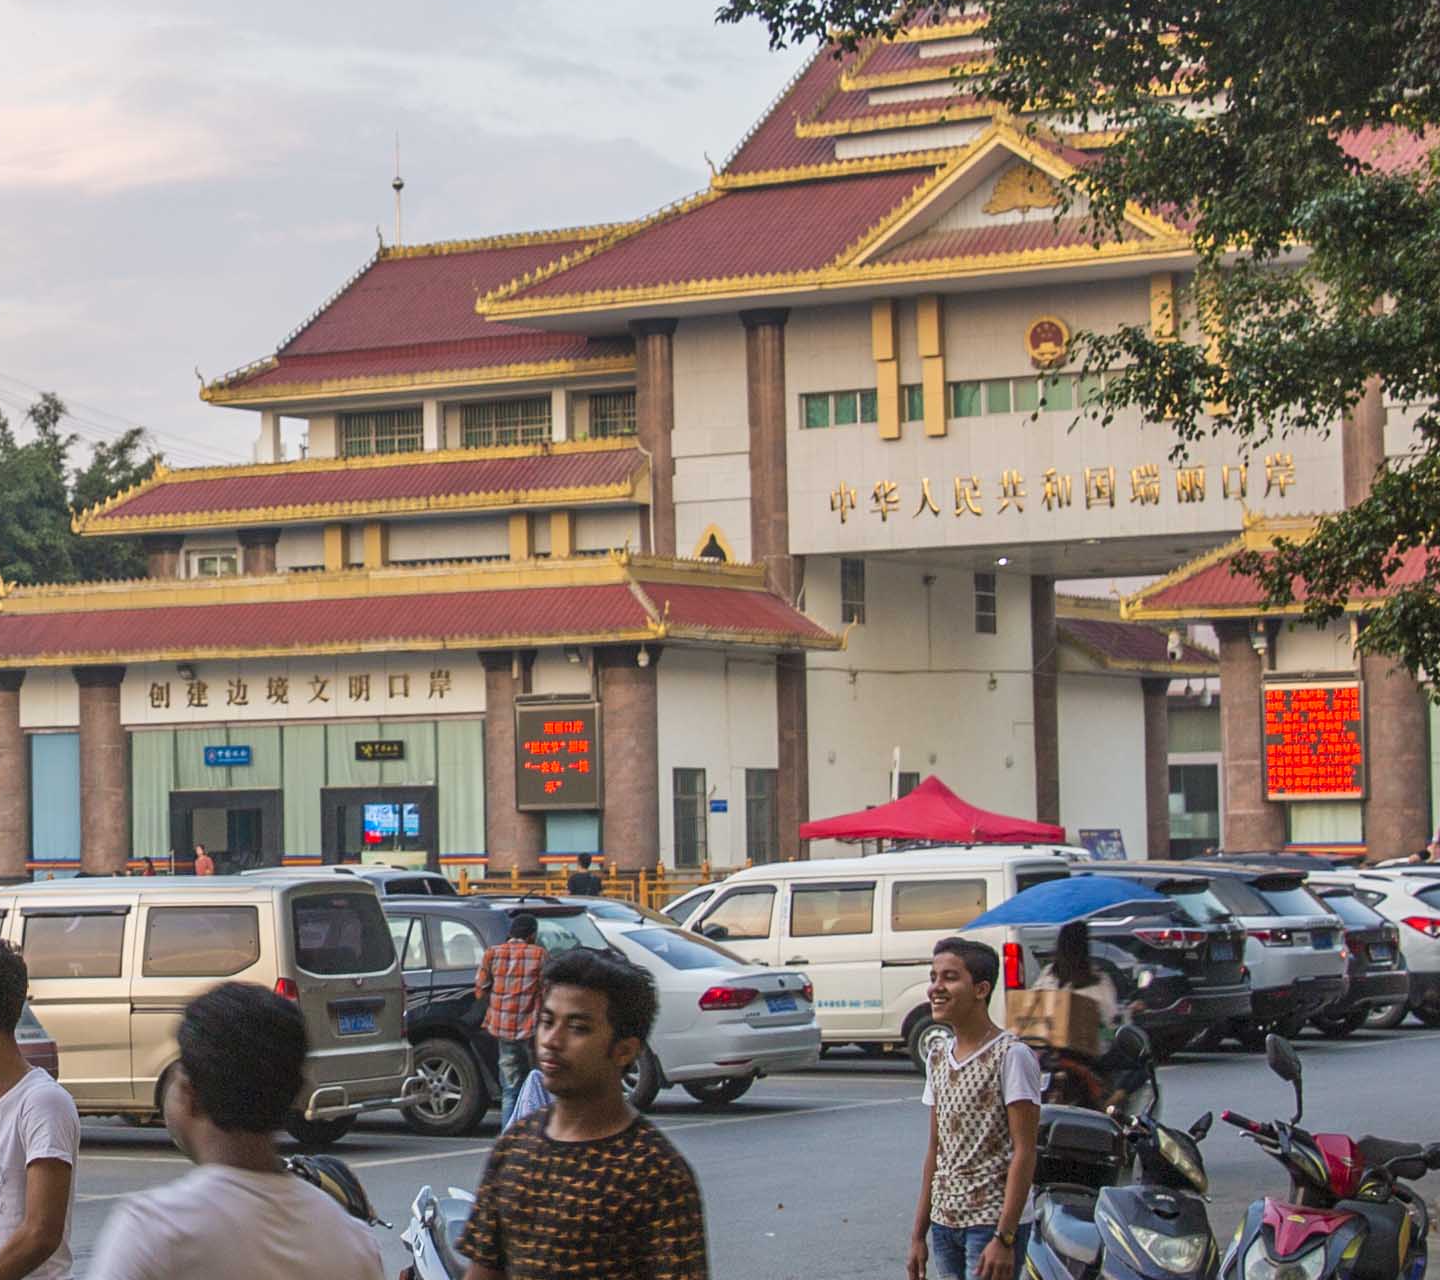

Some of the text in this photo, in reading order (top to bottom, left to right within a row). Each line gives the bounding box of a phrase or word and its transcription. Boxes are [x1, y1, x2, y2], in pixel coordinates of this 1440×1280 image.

[829, 451, 1297, 524] 中华人民共和国瑞丽口岸
[149, 669, 452, 709] 创建边境文明口岸
